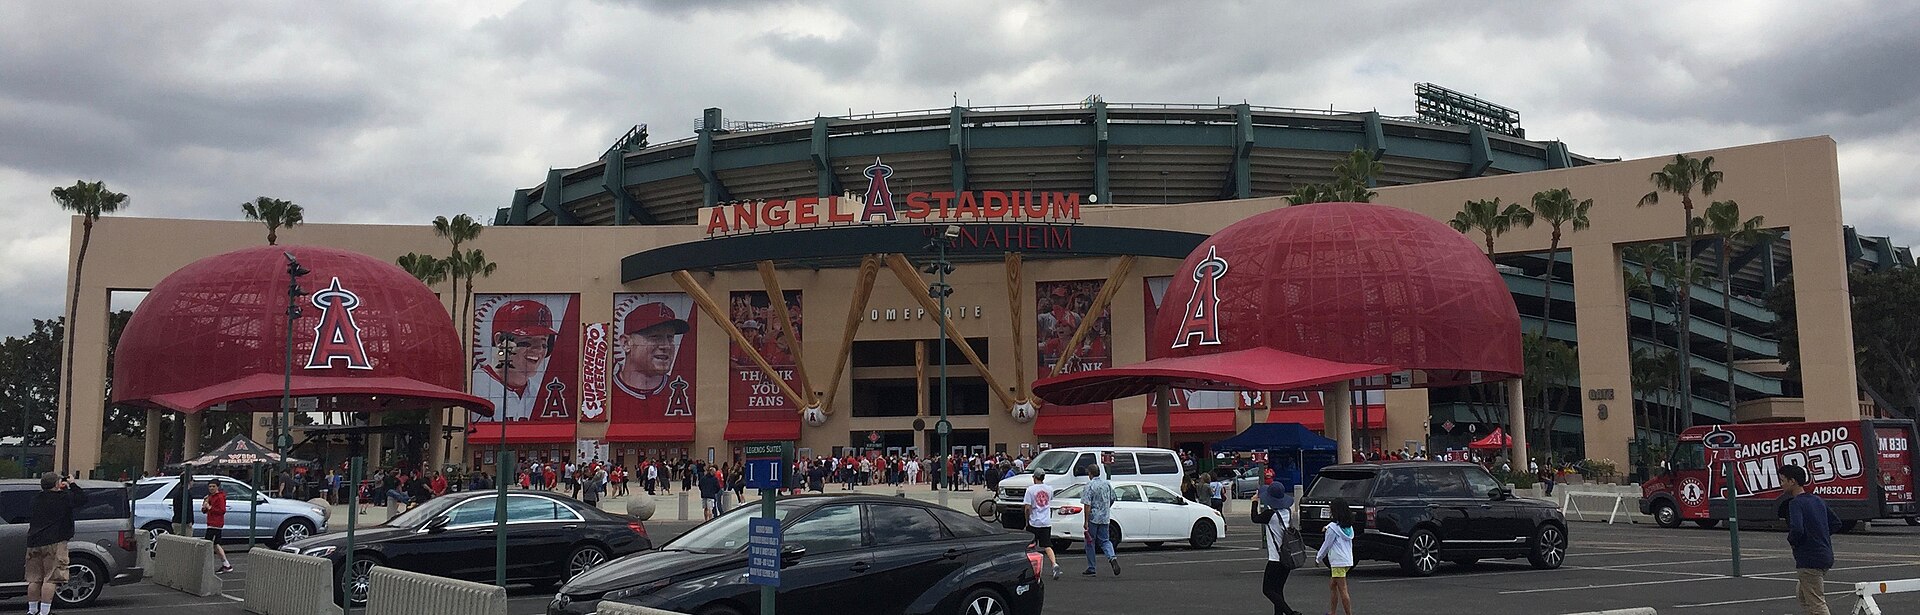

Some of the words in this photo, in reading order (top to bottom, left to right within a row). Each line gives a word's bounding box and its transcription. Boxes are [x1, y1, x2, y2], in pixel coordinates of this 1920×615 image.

[707, 196, 855, 235] ANGEL
[905, 191, 1081, 219] STADIUM
[949, 226, 1072, 249] NAHEIM
[304, 277, 373, 370] A
[584, 328, 600, 410] SUPERHERO
[594, 341, 608, 401] WEEKEND
[752, 384, 780, 395] YOU
[748, 397, 784, 407] FANS
[1742, 436, 1797, 458] ANGELS
[1800, 426, 1848, 448] RADIO
[1889, 437, 1908, 451] 830
[1713, 450, 1719, 459] 7
[1735, 450, 1741, 459] 8
[1813, 486, 1863, 495] AM830.NET
